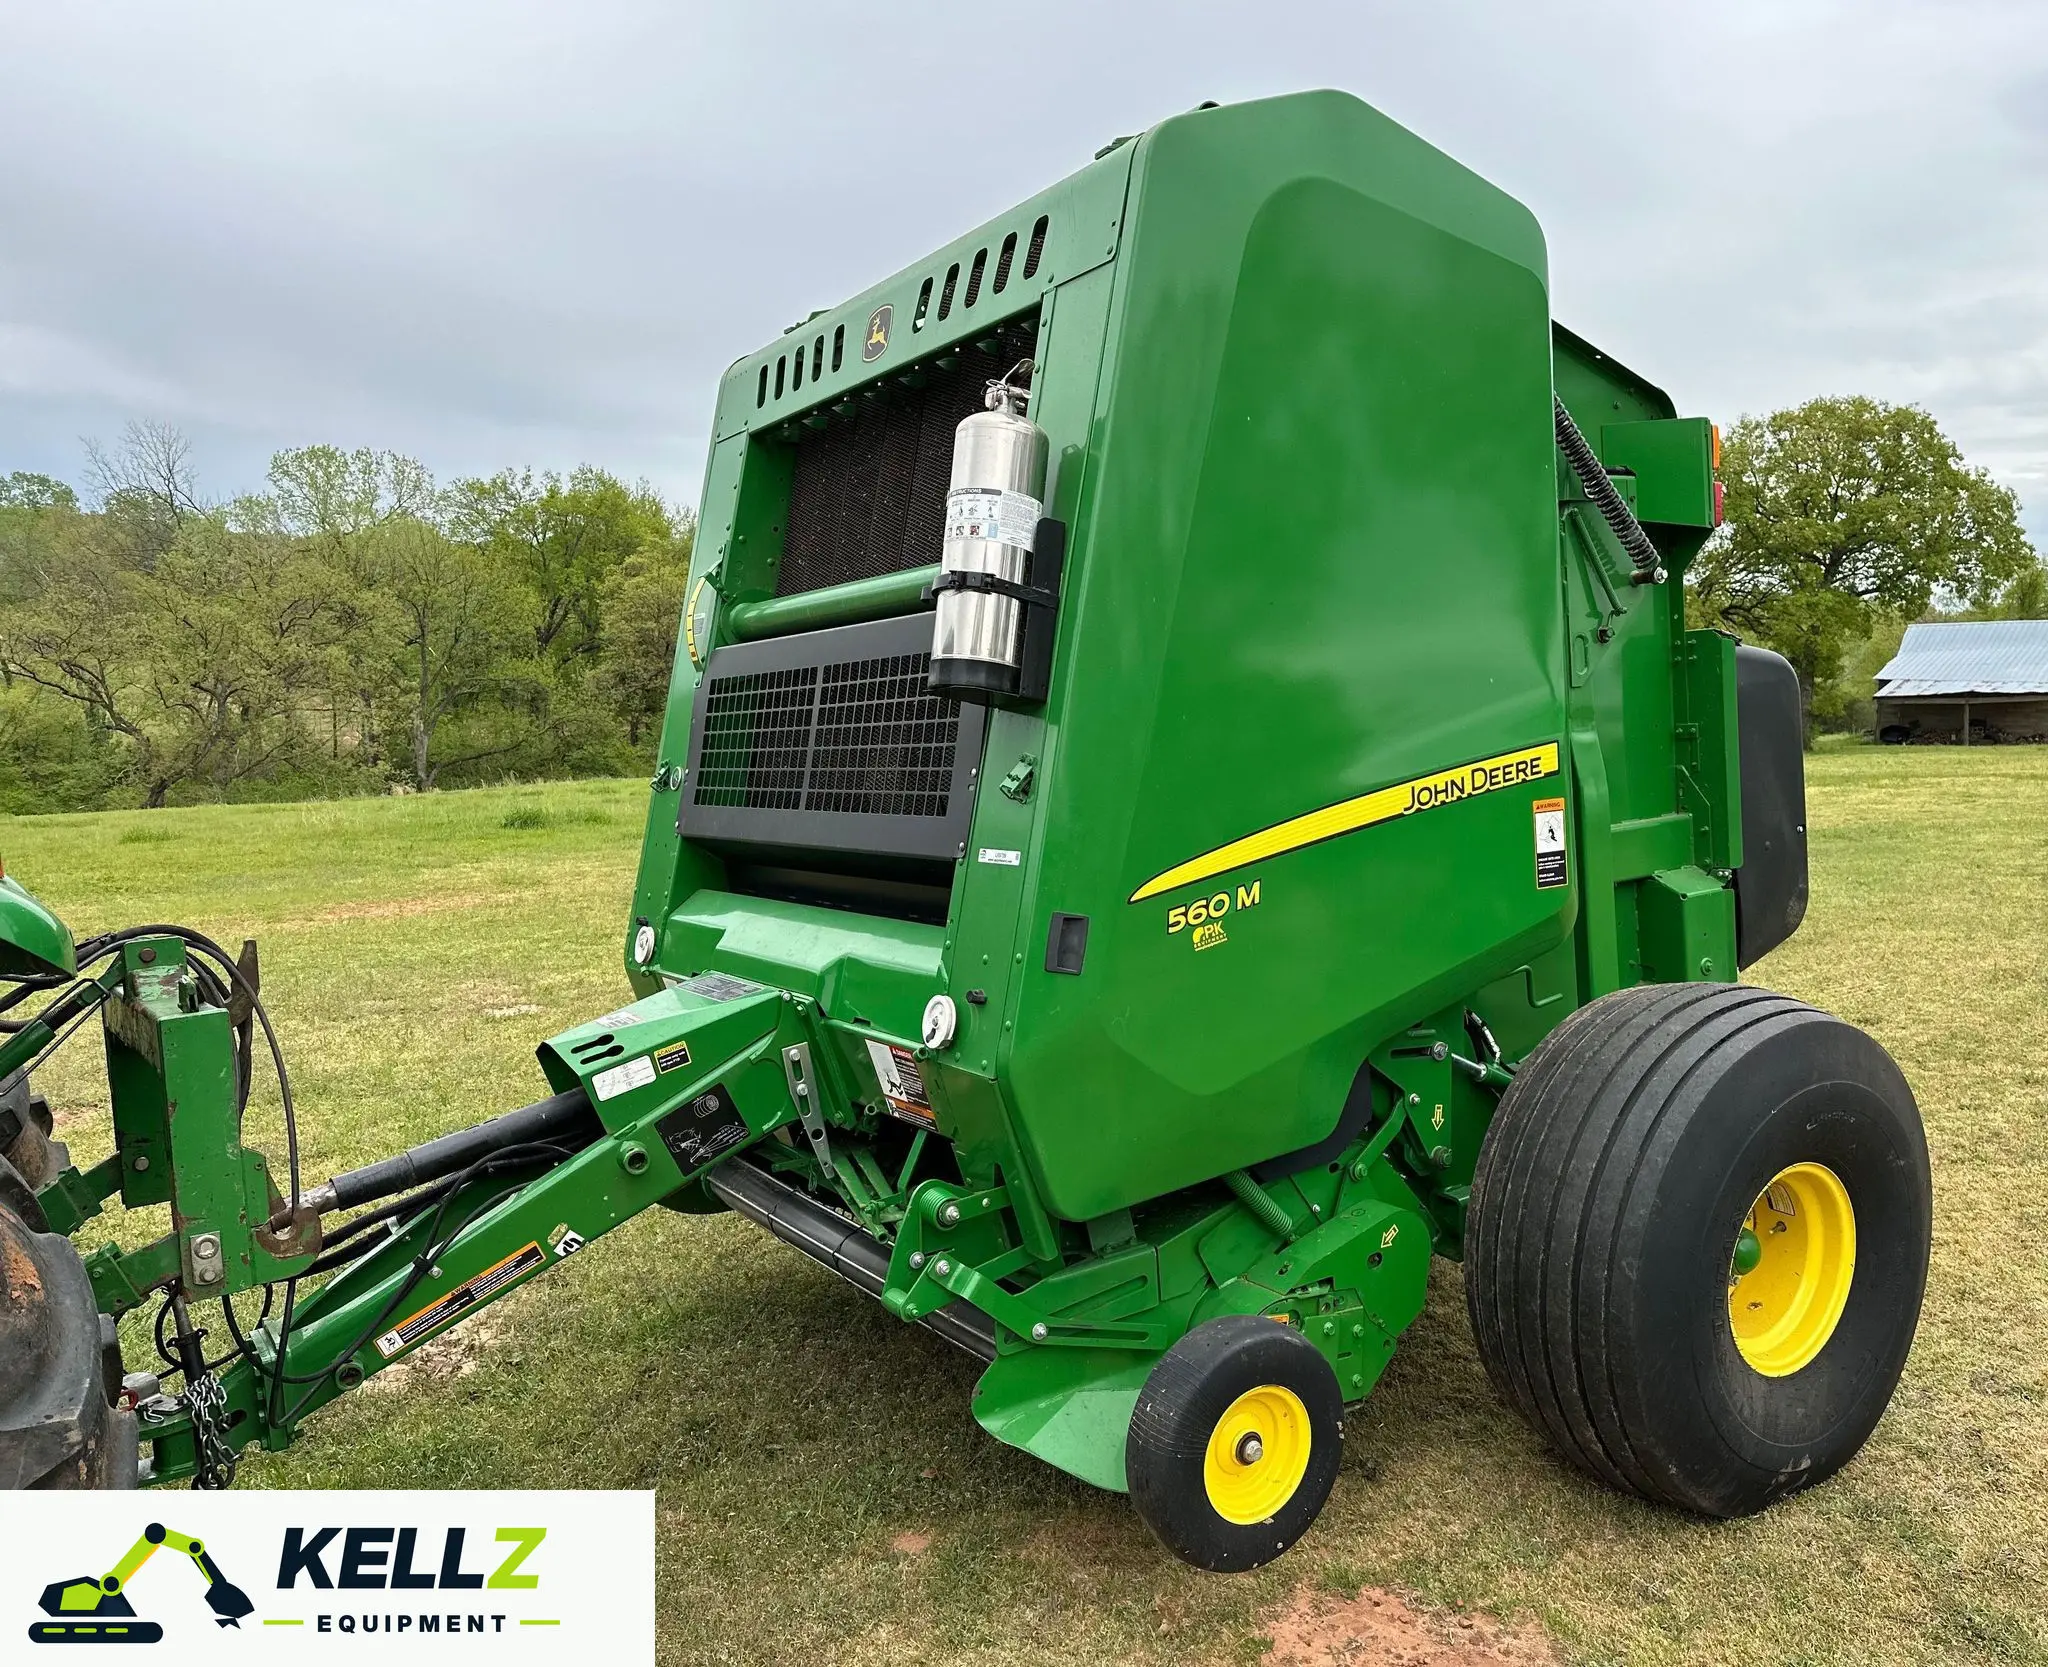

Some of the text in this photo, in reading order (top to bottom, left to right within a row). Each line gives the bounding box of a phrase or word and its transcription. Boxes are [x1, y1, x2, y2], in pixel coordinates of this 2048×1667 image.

[1403, 756, 1542, 812] JOHN DEERE
[1168, 879, 1261, 934] 560 M
